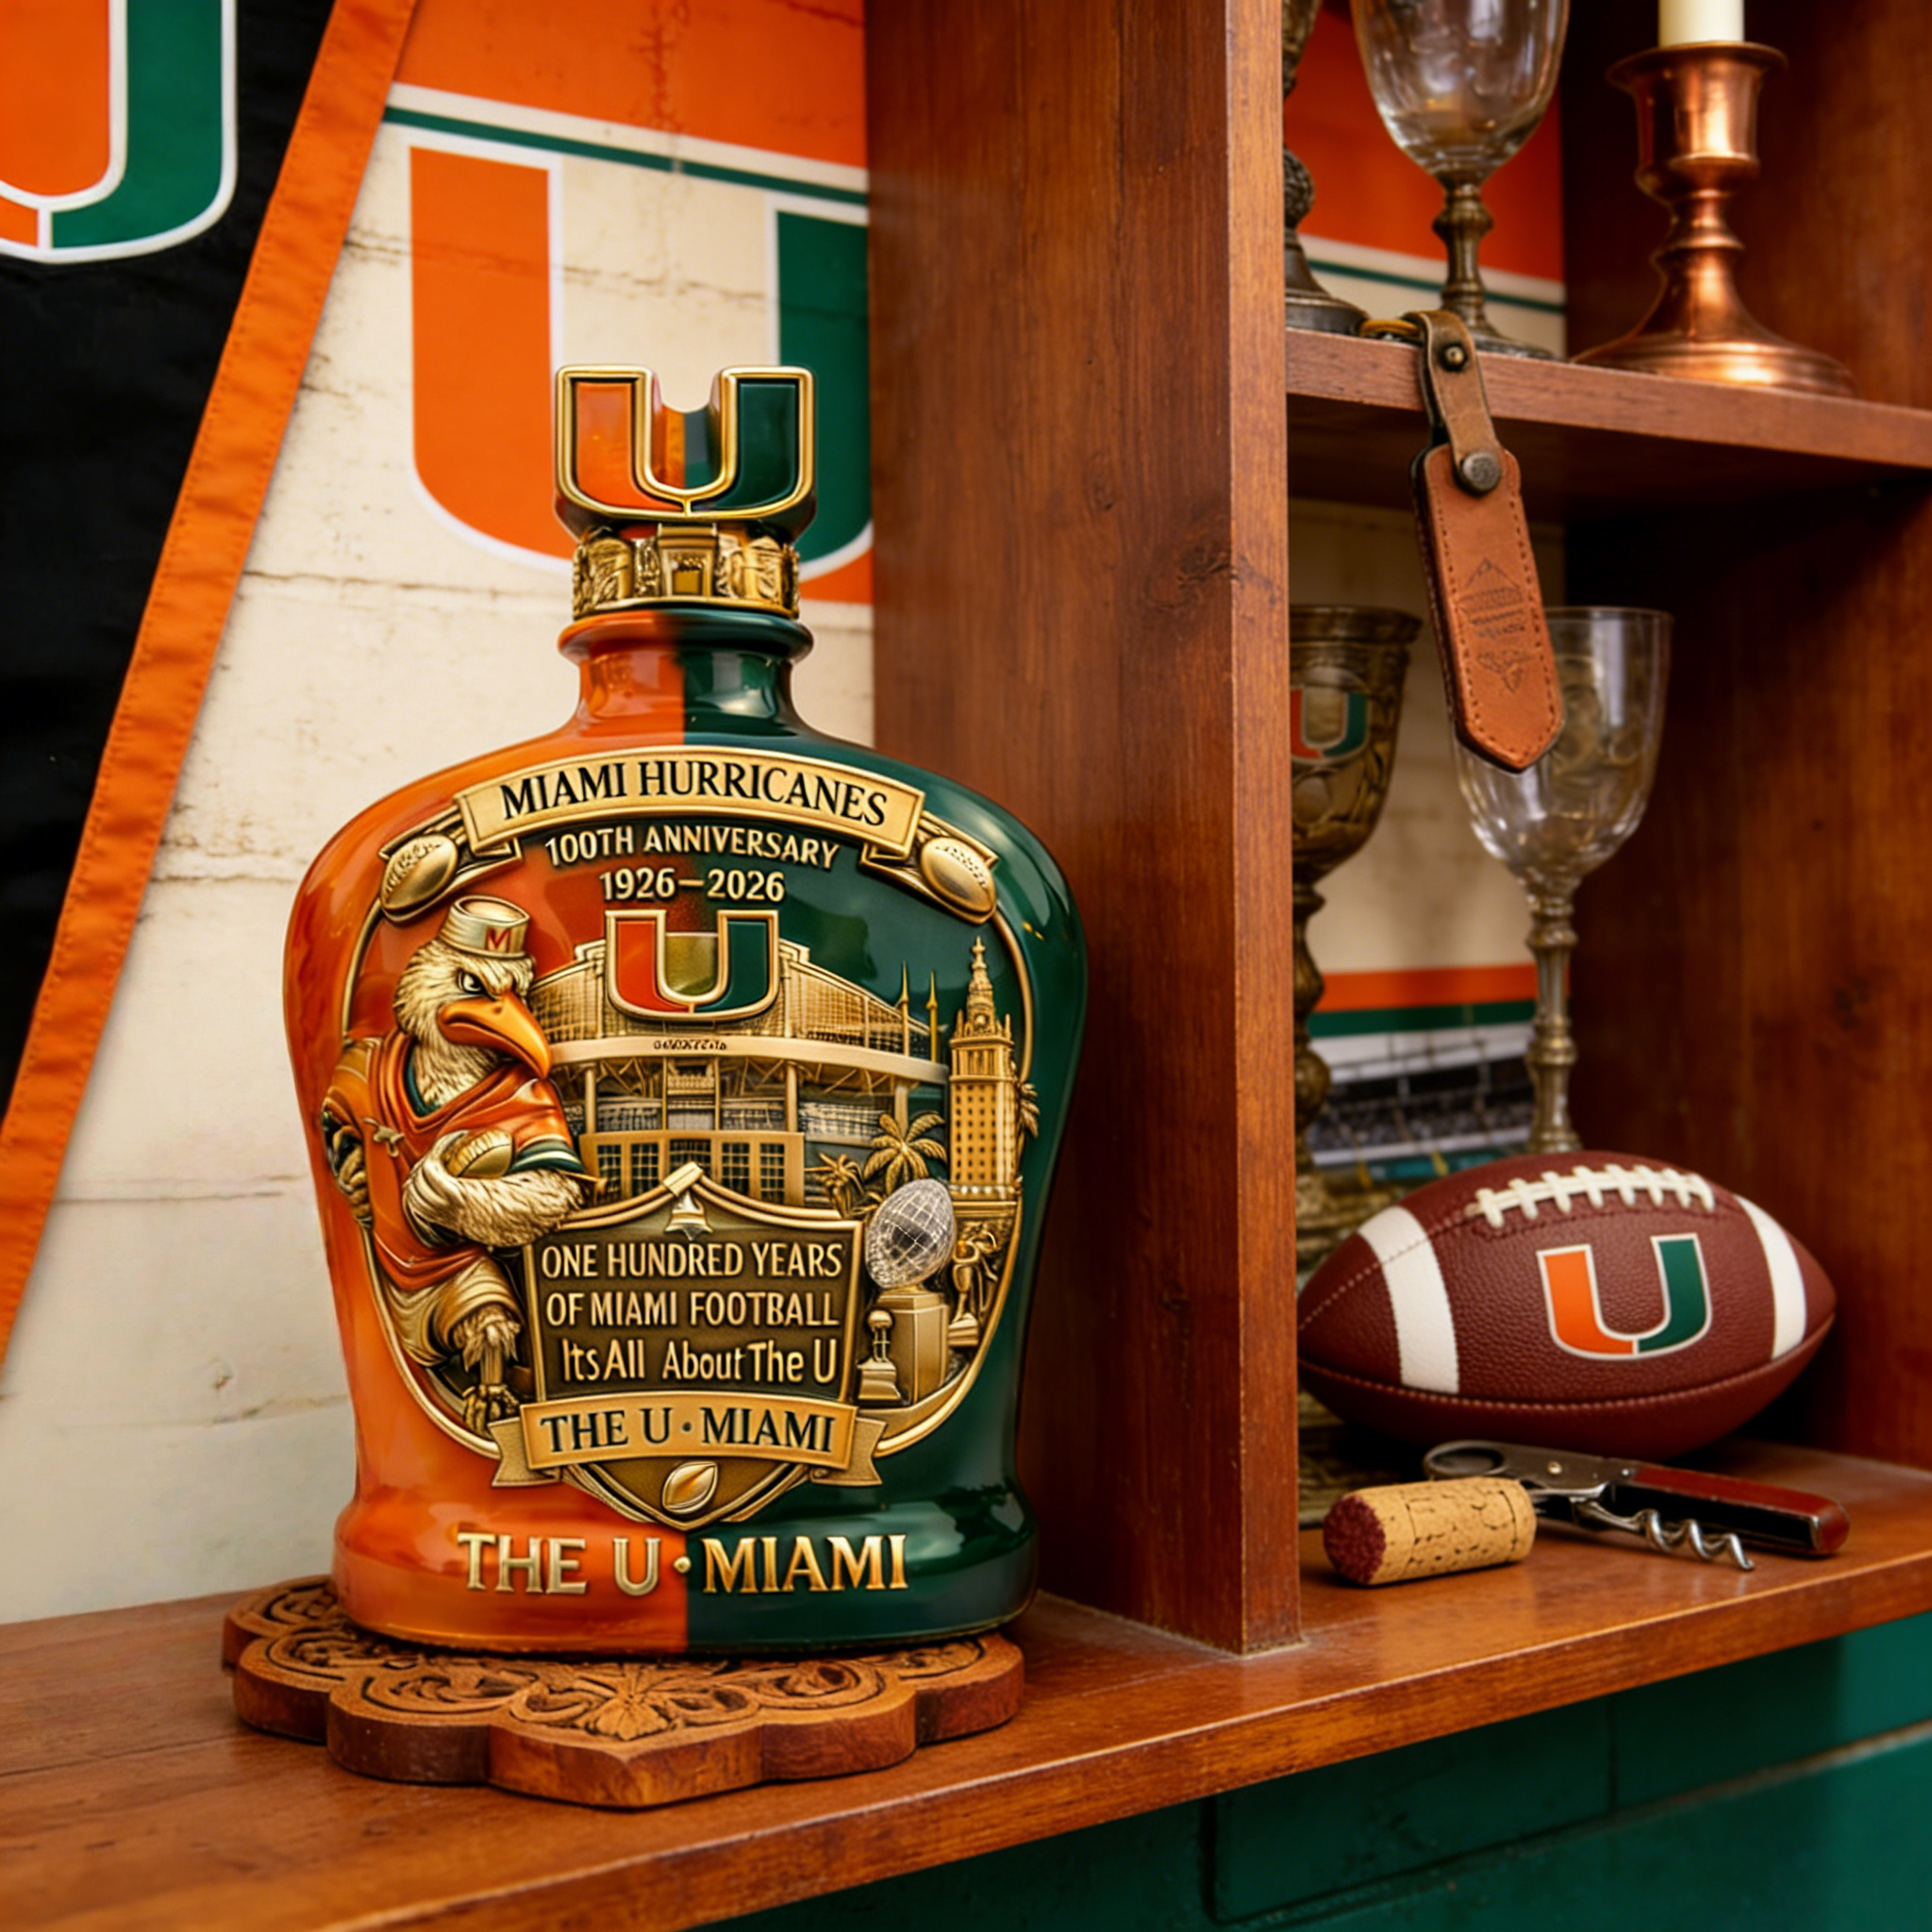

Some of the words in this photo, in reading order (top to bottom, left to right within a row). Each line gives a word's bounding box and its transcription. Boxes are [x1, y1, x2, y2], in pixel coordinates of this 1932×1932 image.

[556, 364, 815, 519] U
[500, 762, 626, 819] MIAMI
[638, 760, 888, 826] HURRICANES
[545, 824, 633, 866] 100TH
[642, 824, 840, 870] ANNIVERSARY
[485, 927, 512, 953] M
[605, 909, 779, 1022] U
[541, 1244, 598, 1278] ONE
[608, 1242, 743, 1276] HUNDRED
[751, 1241, 842, 1277] YEARS
[546, 1291, 585, 1326] OF
[591, 1291, 677, 1326] MIAMI
[690, 1291, 841, 1326] FOOTBALL
[1536, 1232, 1713, 1361] U
[561, 1338, 600, 1381] Its
[603, 1338, 645, 1380] All
[662, 1340, 746, 1380] About
[747, 1339, 805, 1383] The
[814, 1339, 838, 1383] U
[540, 1409, 629, 1453] THE
[640, 1407, 674, 1444] U
[701, 1407, 836, 1454] MIAMI
[458, 1534, 587, 1594] THE
[612, 1537, 661, 1597] U
[701, 1534, 910, 1594] MIAMI
